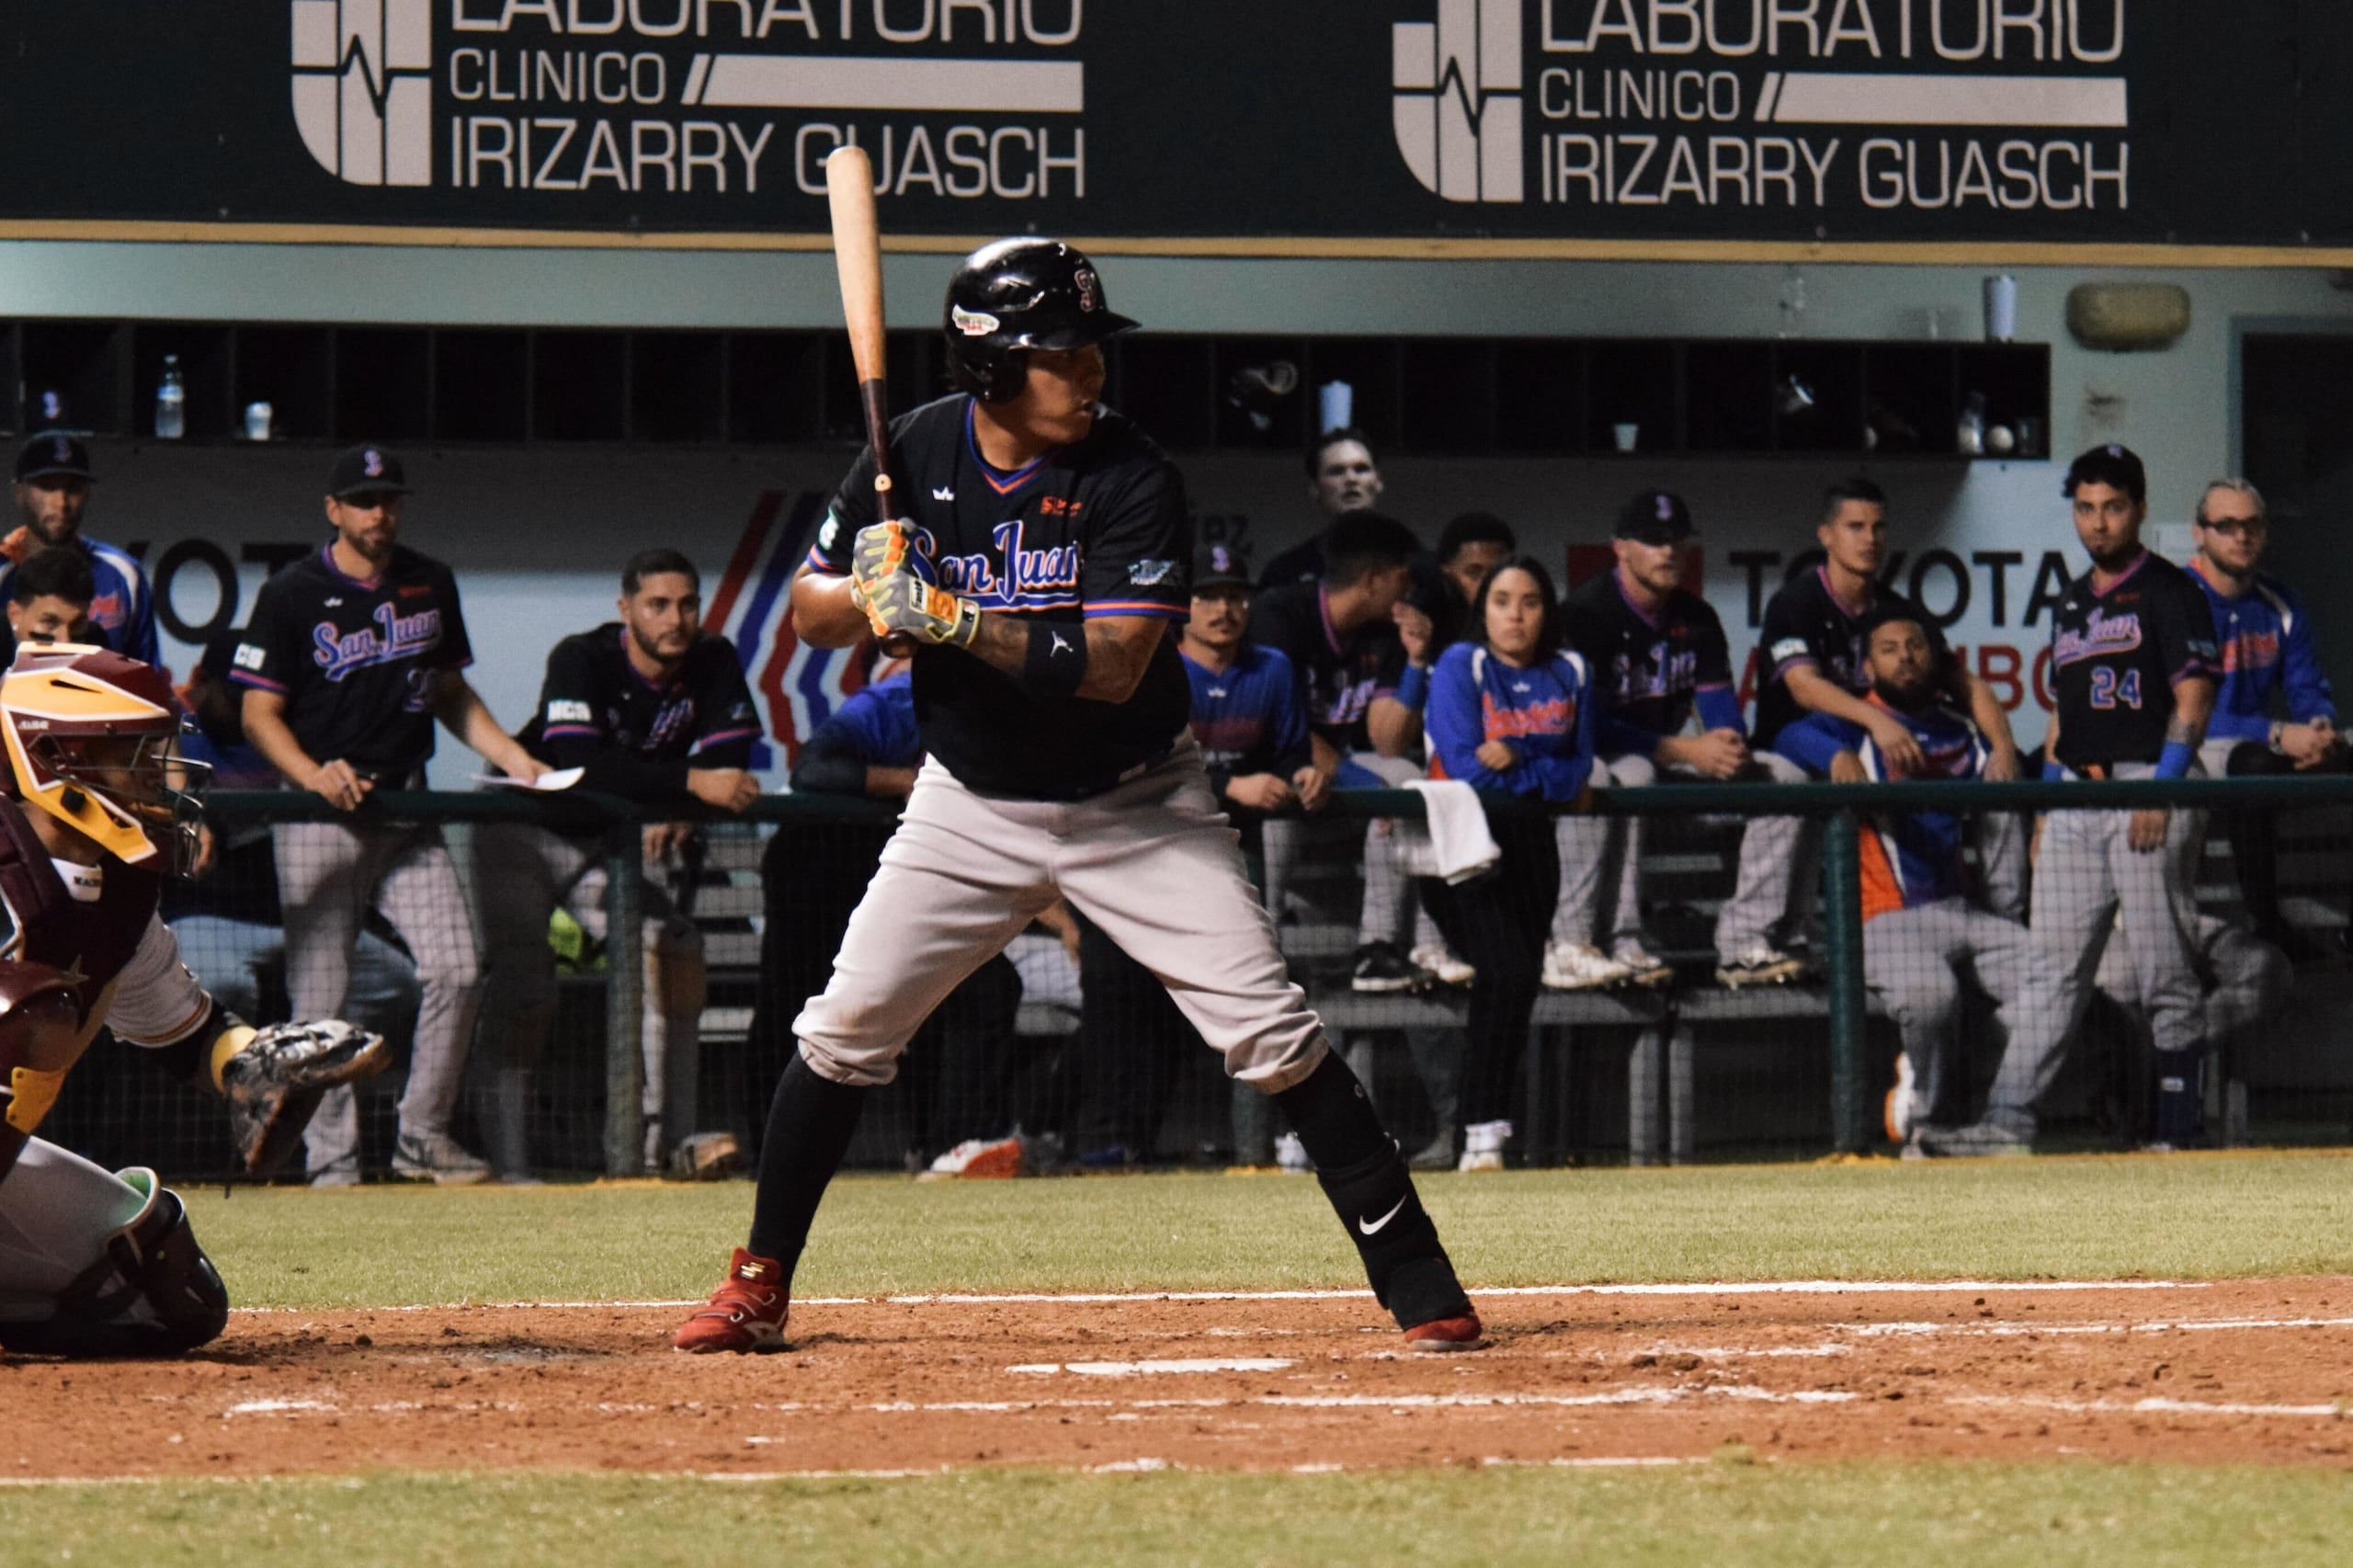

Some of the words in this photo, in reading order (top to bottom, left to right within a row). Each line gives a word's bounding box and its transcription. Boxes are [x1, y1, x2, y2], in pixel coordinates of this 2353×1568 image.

[1541, 0, 2124, 62] LABORATORIO
[450, 49, 665, 104] CLINICO
[1540, 69, 1740, 120] CLINICO
[452, 117, 774, 193] IRIZARRY
[795, 123, 1085, 198] GUASCH
[1541, 134, 1840, 205] IRIZARRY
[1859, 139, 2129, 208] GUASCH
[910, 526, 995, 594] San
[1729, 549, 2075, 628] TOTA
[313, 621, 378, 667] San
[2091, 665, 2142, 710] 24
